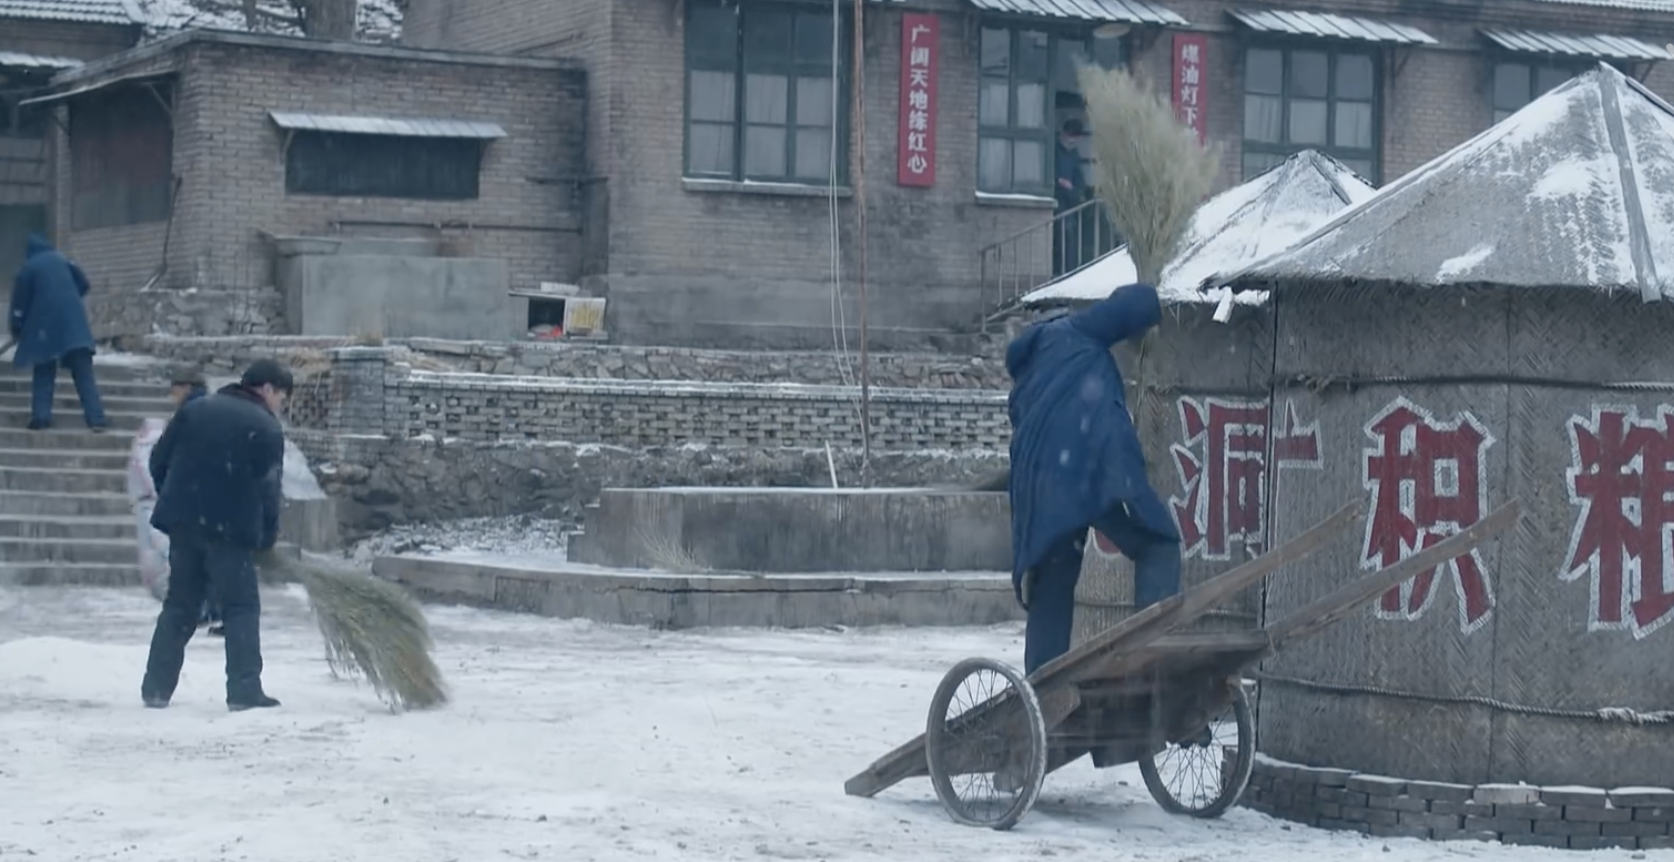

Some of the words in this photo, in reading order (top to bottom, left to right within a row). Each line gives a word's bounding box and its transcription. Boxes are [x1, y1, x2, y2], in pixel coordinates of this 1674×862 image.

[908, 24, 931, 174] 广阔天地练红心
